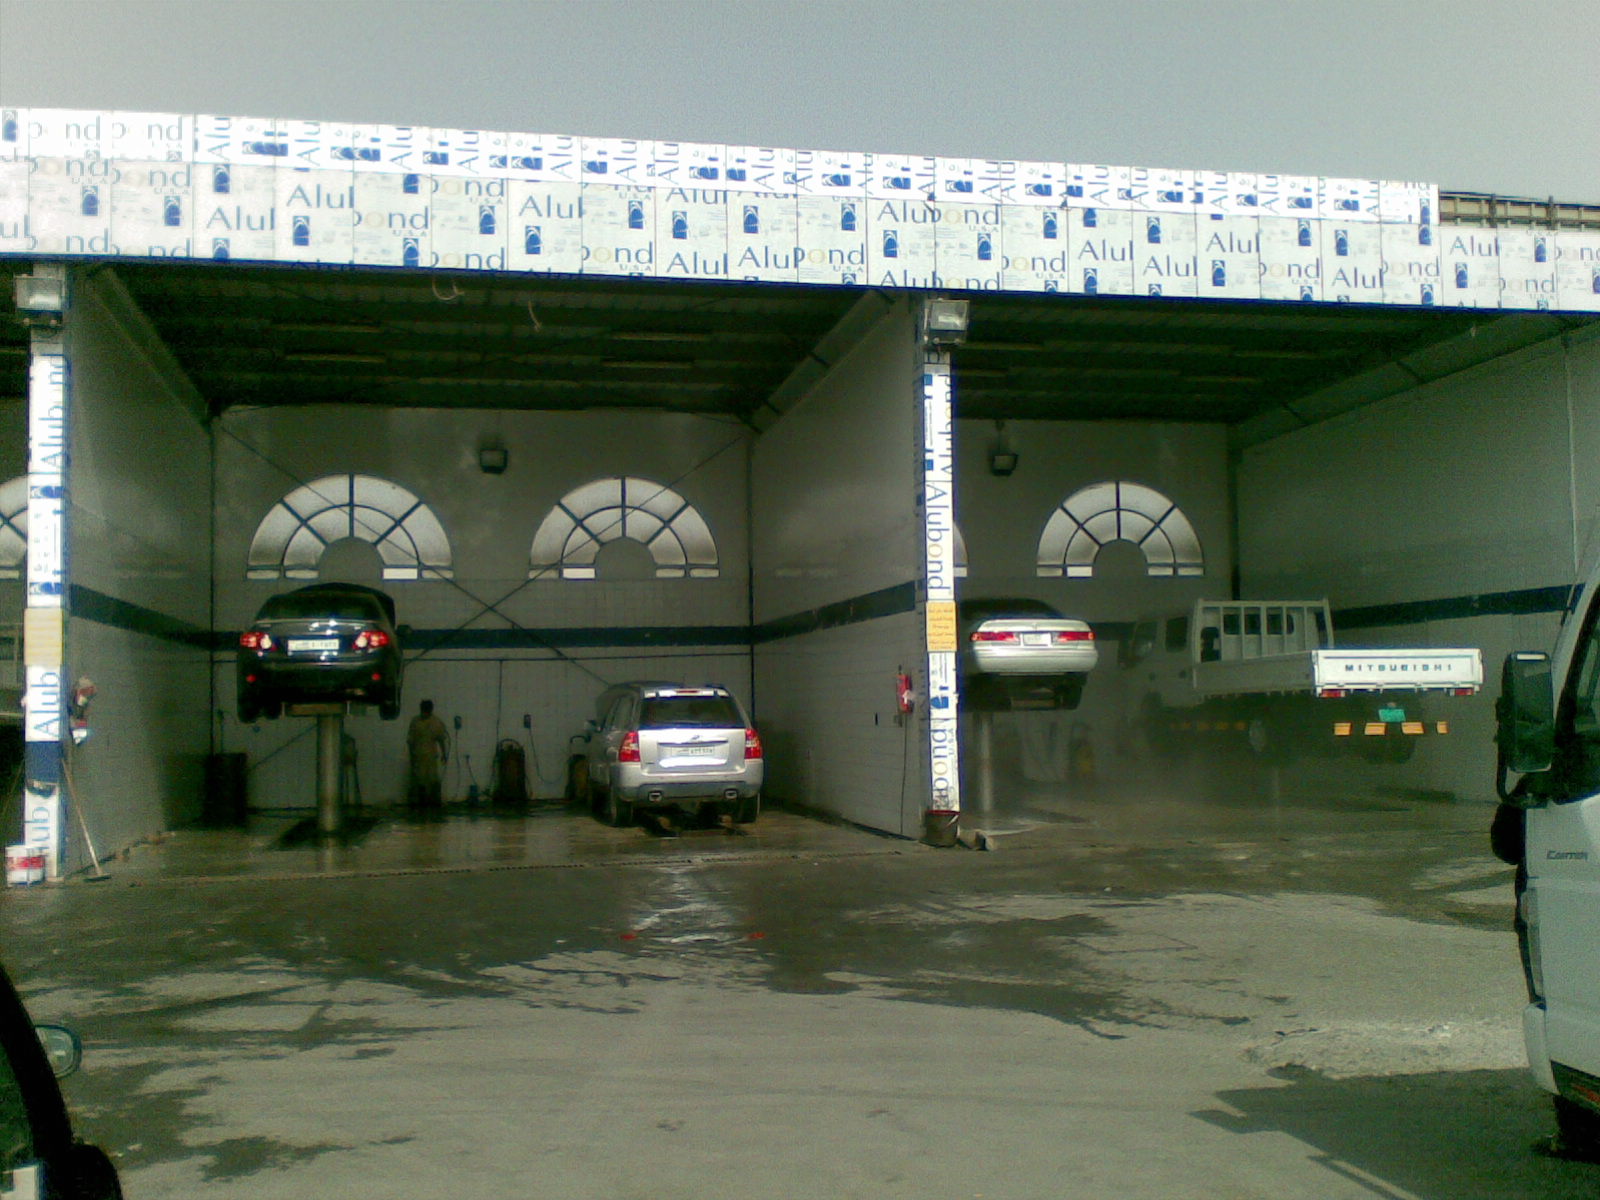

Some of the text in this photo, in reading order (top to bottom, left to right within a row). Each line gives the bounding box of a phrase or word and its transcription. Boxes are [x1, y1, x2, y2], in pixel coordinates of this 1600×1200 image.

[877, 201, 1000, 225] Alubond
[926, 484, 951, 590] Alubond
[1345, 663, 1452, 672] MITSUBISHI
